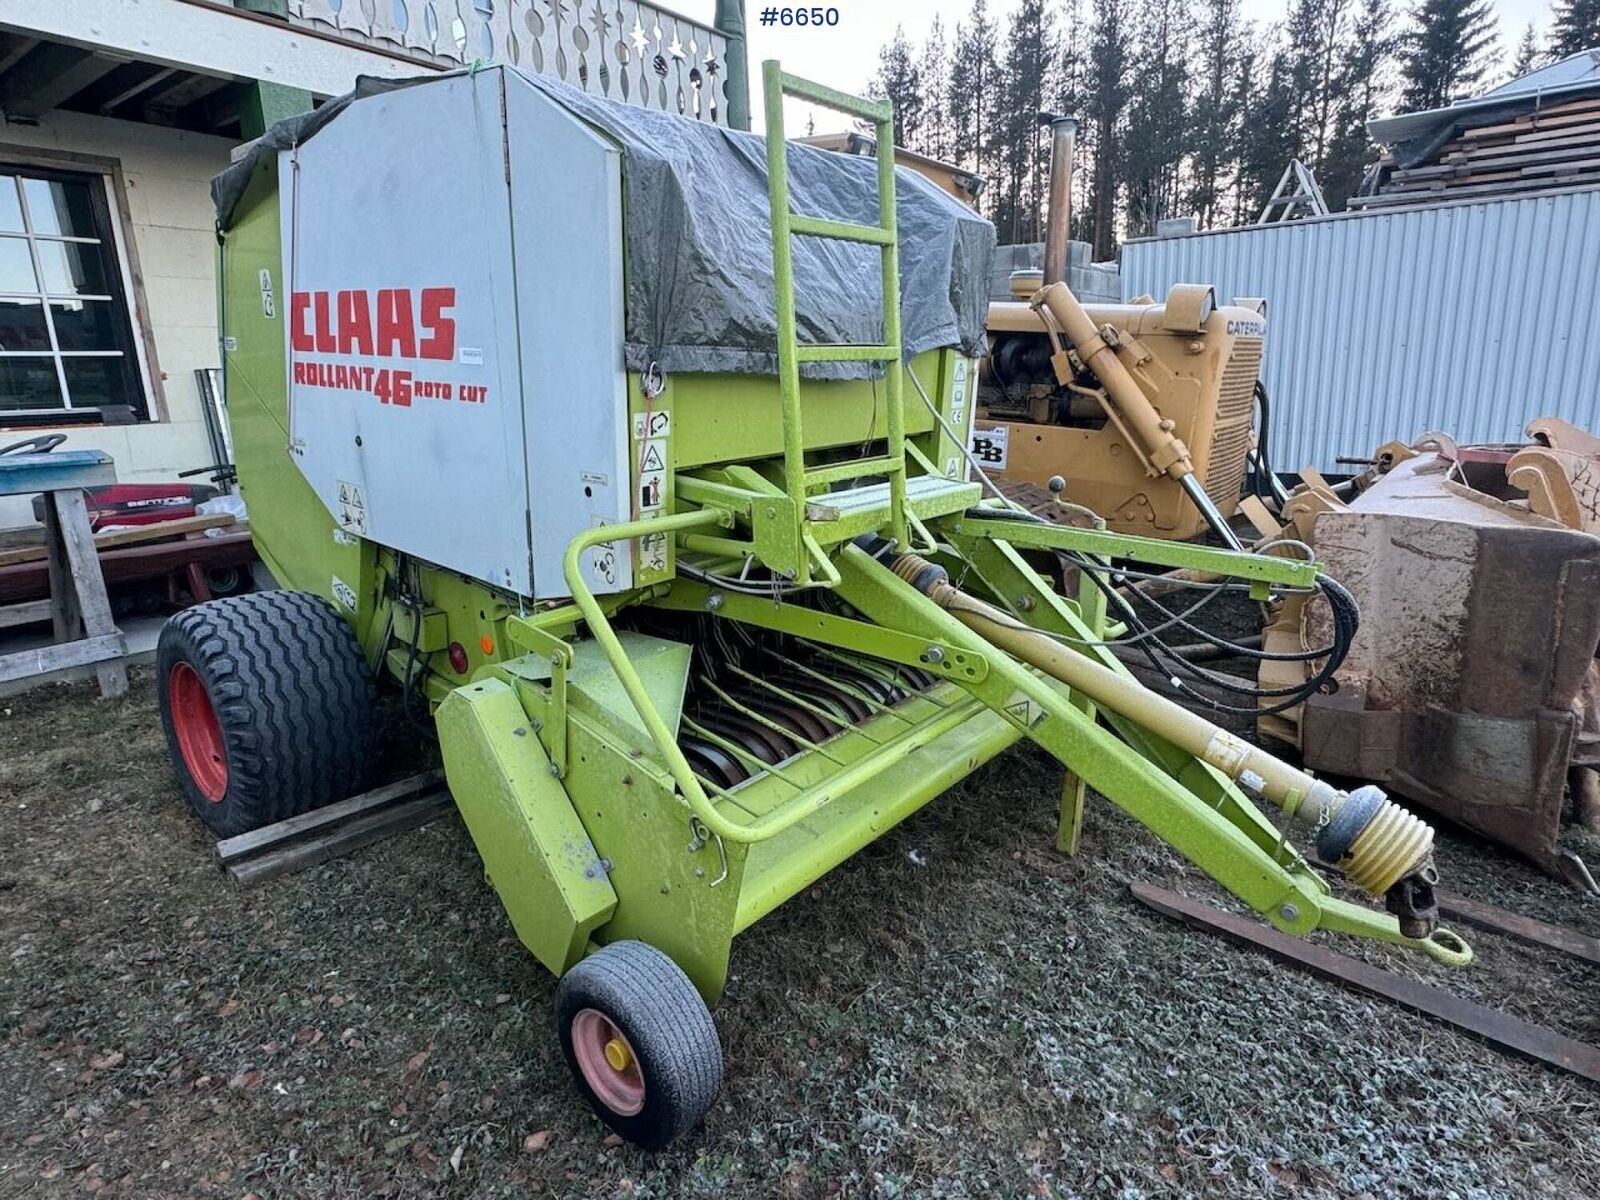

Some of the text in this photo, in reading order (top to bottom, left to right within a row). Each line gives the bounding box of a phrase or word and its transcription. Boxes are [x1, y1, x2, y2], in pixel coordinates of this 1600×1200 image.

[291, 287, 455, 360] CLAAS
[294, 362, 488, 407] ROLLANT 46 ROTO CUT
